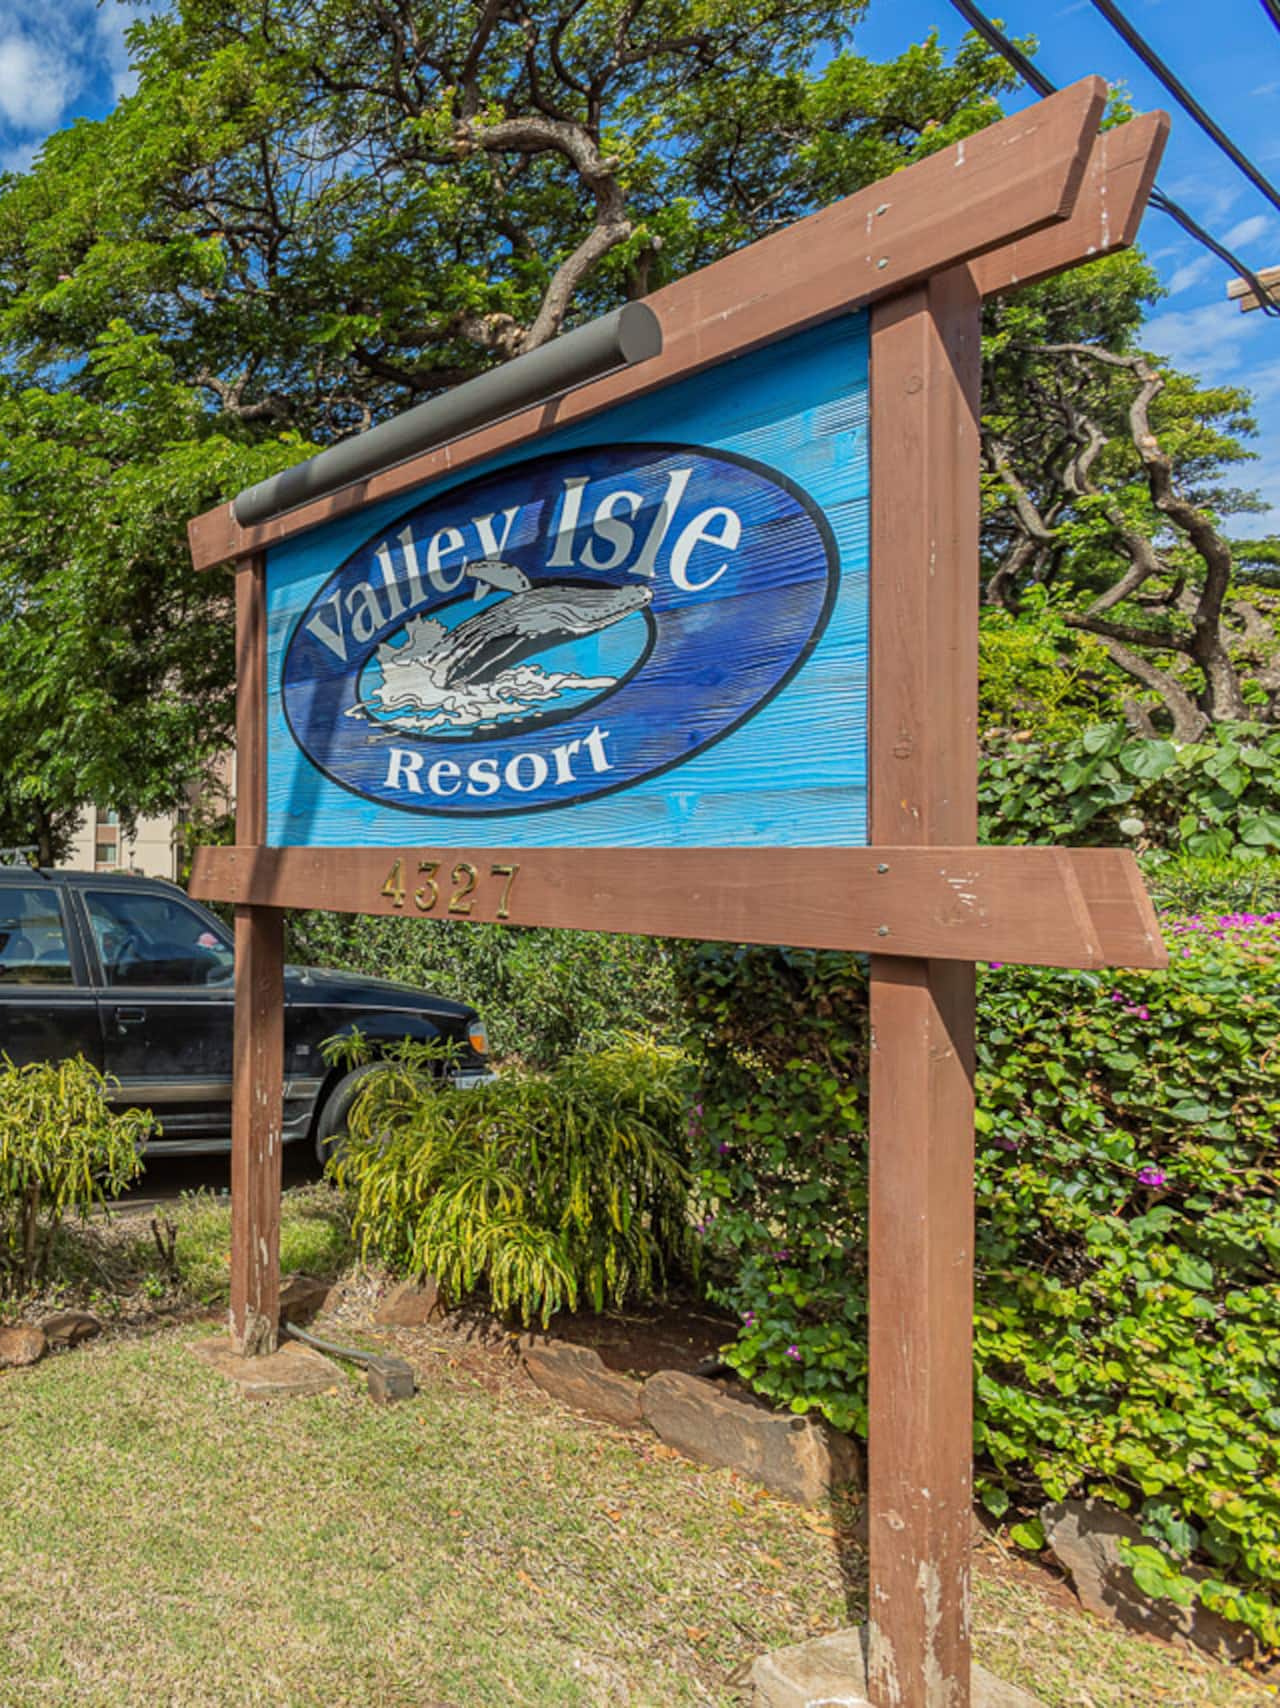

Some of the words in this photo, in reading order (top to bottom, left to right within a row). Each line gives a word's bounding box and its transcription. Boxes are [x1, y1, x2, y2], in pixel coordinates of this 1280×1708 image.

[305, 506, 521, 663] Valley
[545, 467, 743, 592] Isle
[383, 724, 614, 796] Resort
[381, 857, 521, 919] 4327
